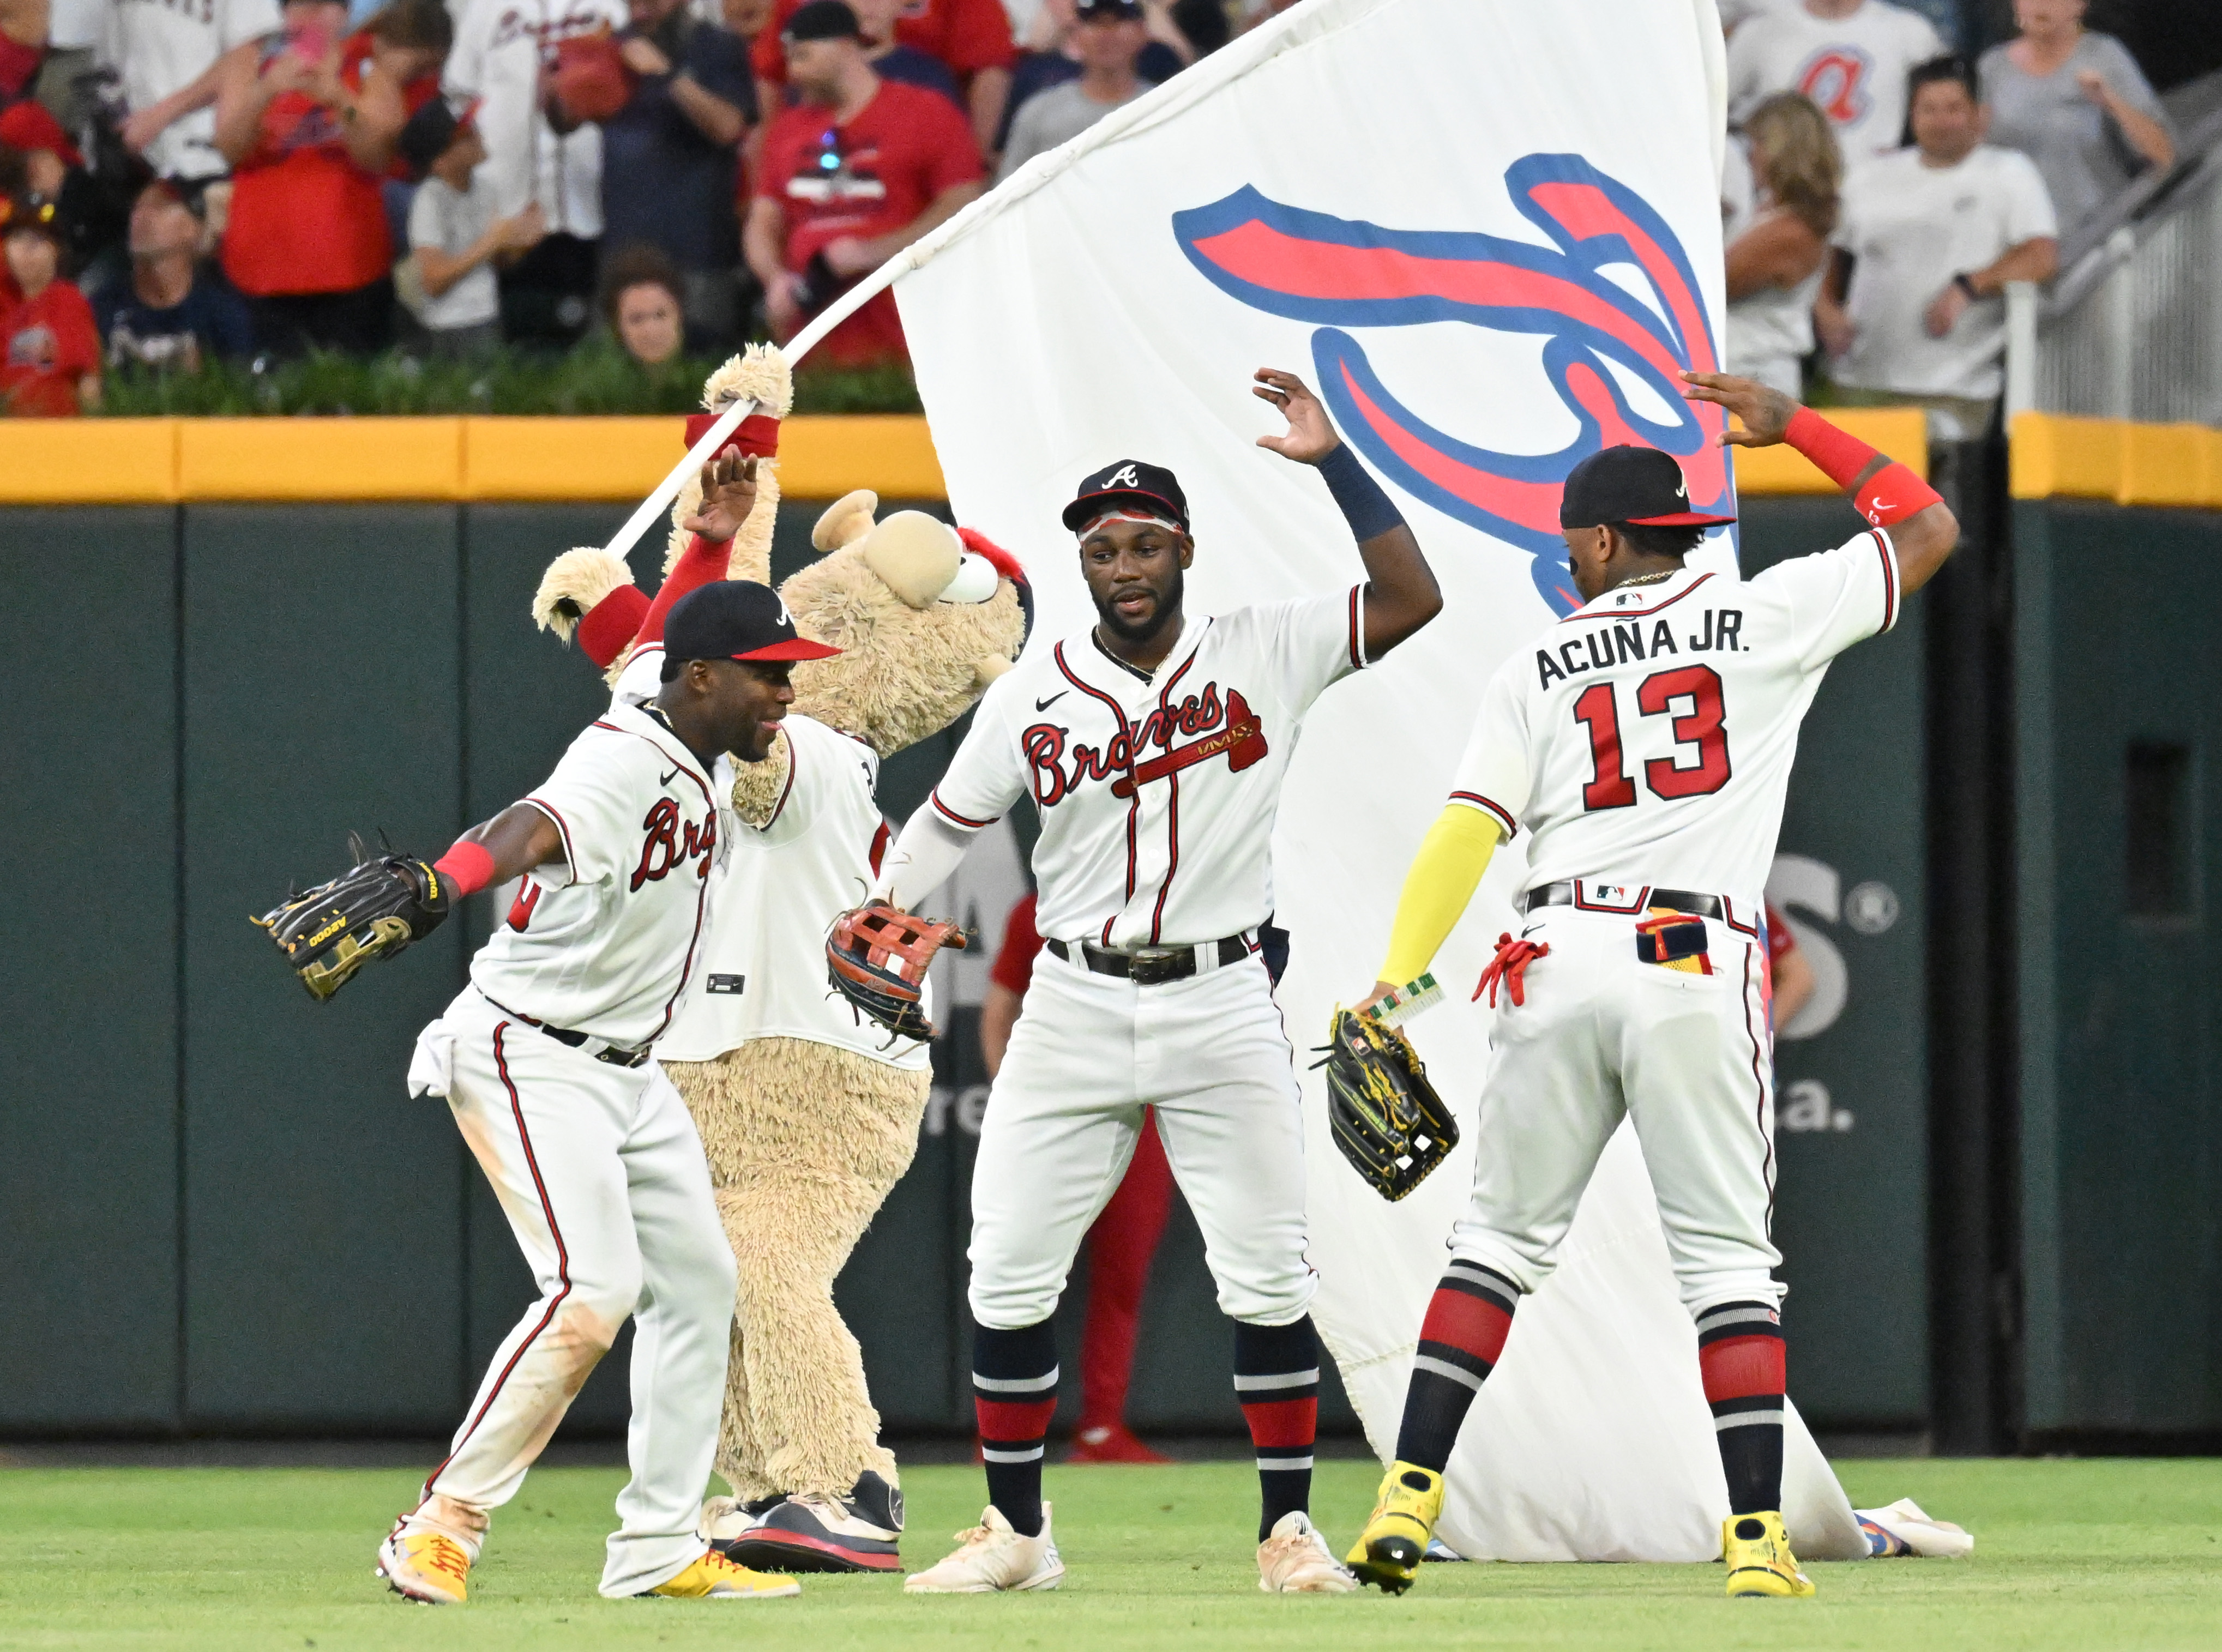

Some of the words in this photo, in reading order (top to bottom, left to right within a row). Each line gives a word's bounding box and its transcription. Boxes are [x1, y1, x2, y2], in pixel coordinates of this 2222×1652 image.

[1101, 464, 1139, 490] A
[1535, 616, 1678, 692] ACUÑA
[1689, 609, 1750, 652] JR.
[1021, 680, 1223, 815] Braves
[1573, 663, 1732, 812] 13
[309, 915, 347, 947] A2000
